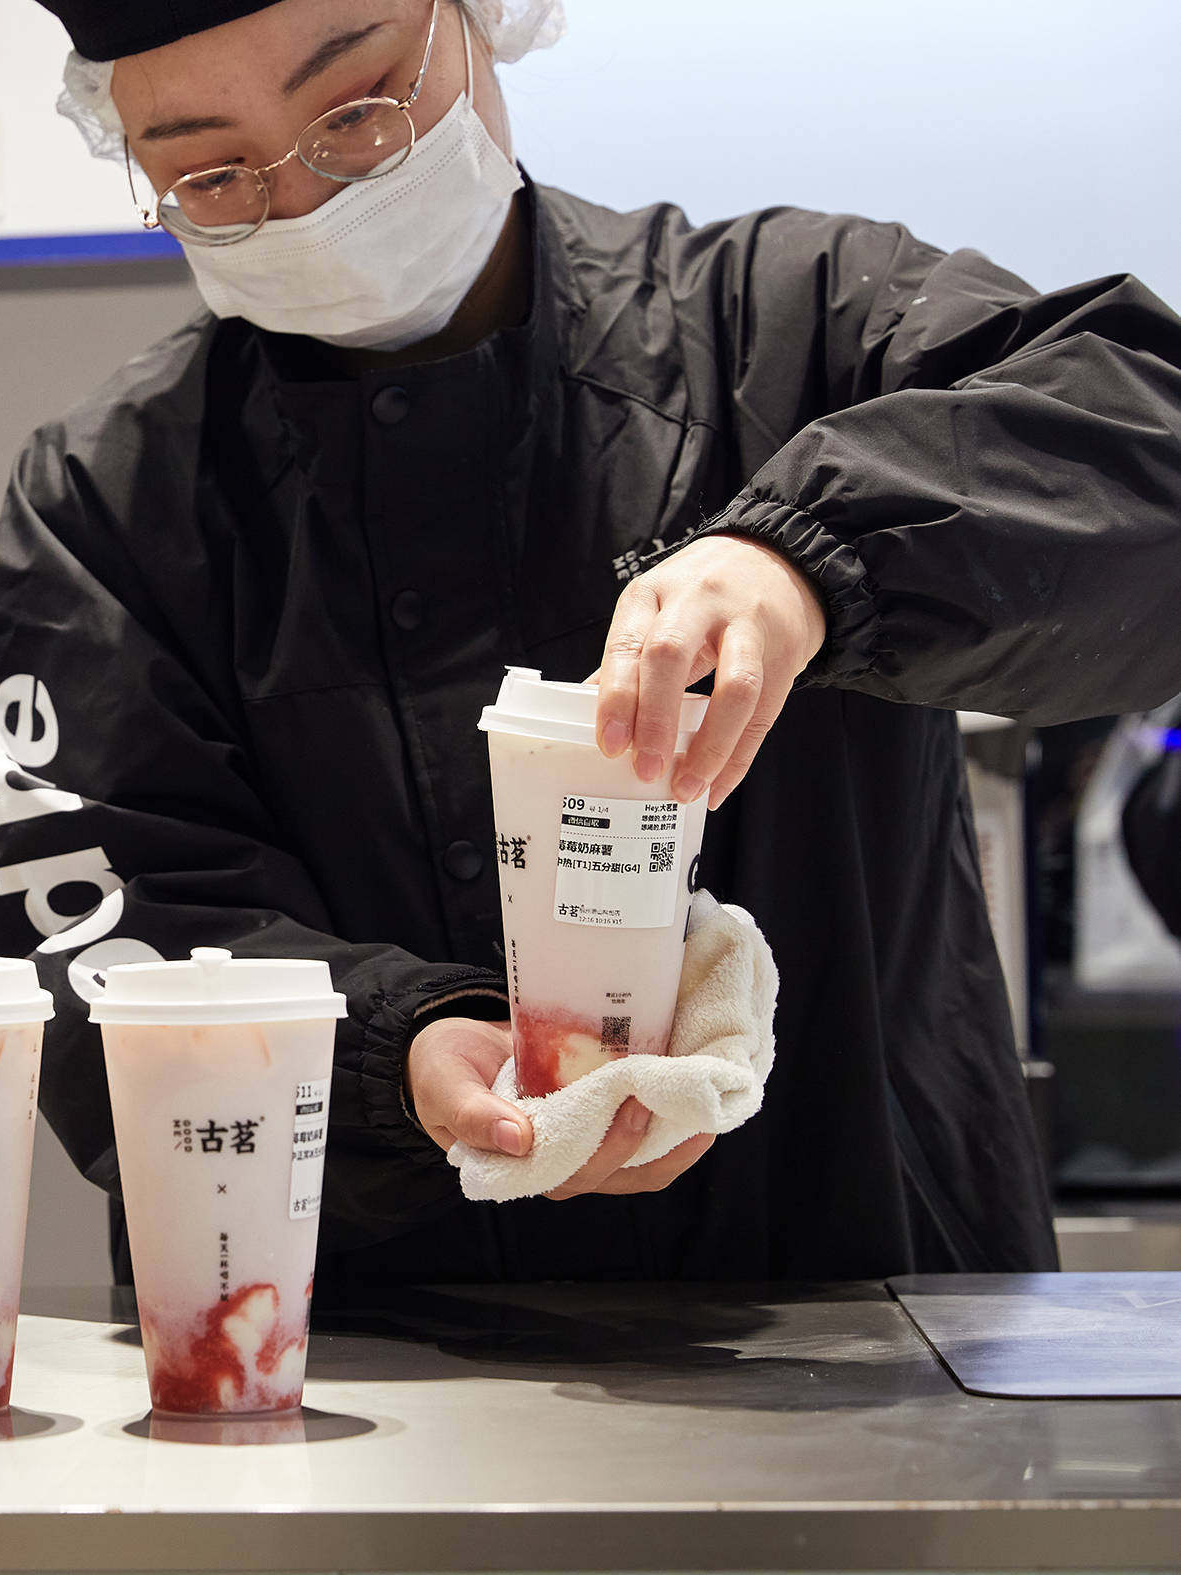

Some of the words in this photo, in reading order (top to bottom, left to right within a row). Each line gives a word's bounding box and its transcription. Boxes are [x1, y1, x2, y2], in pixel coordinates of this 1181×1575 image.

[558, 904, 579, 917] 古茗
[183, 1120, 193, 1153] GOOD
[196, 1120, 259, 1154] 古茗
